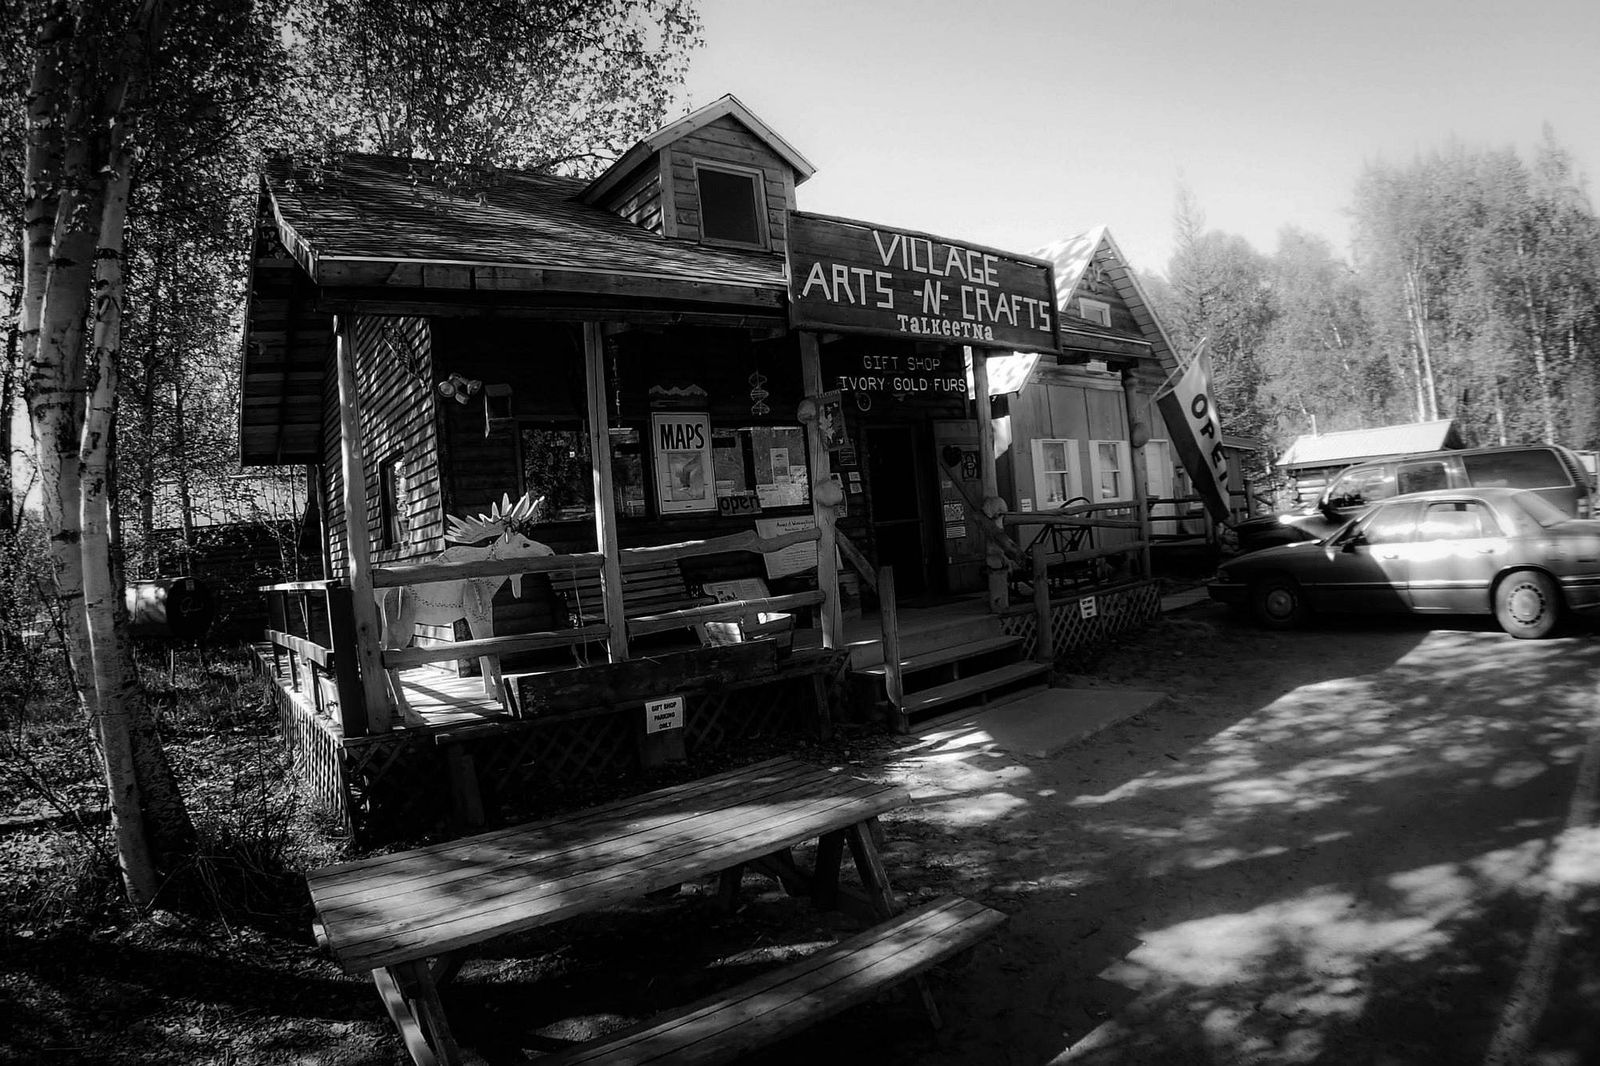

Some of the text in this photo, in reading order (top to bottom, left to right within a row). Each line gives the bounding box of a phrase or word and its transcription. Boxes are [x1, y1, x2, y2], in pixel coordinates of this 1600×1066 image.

[873, 230, 999, 287] VILLAGE
[802, 262, 894, 309] ARTS
[961, 285, 1051, 332] CRAFTS
[863, 355, 941, 371] GIFT SHOP
[839, 376, 967, 392] IVORY GOLD FURS
[660, 423, 704, 449] MAPS
